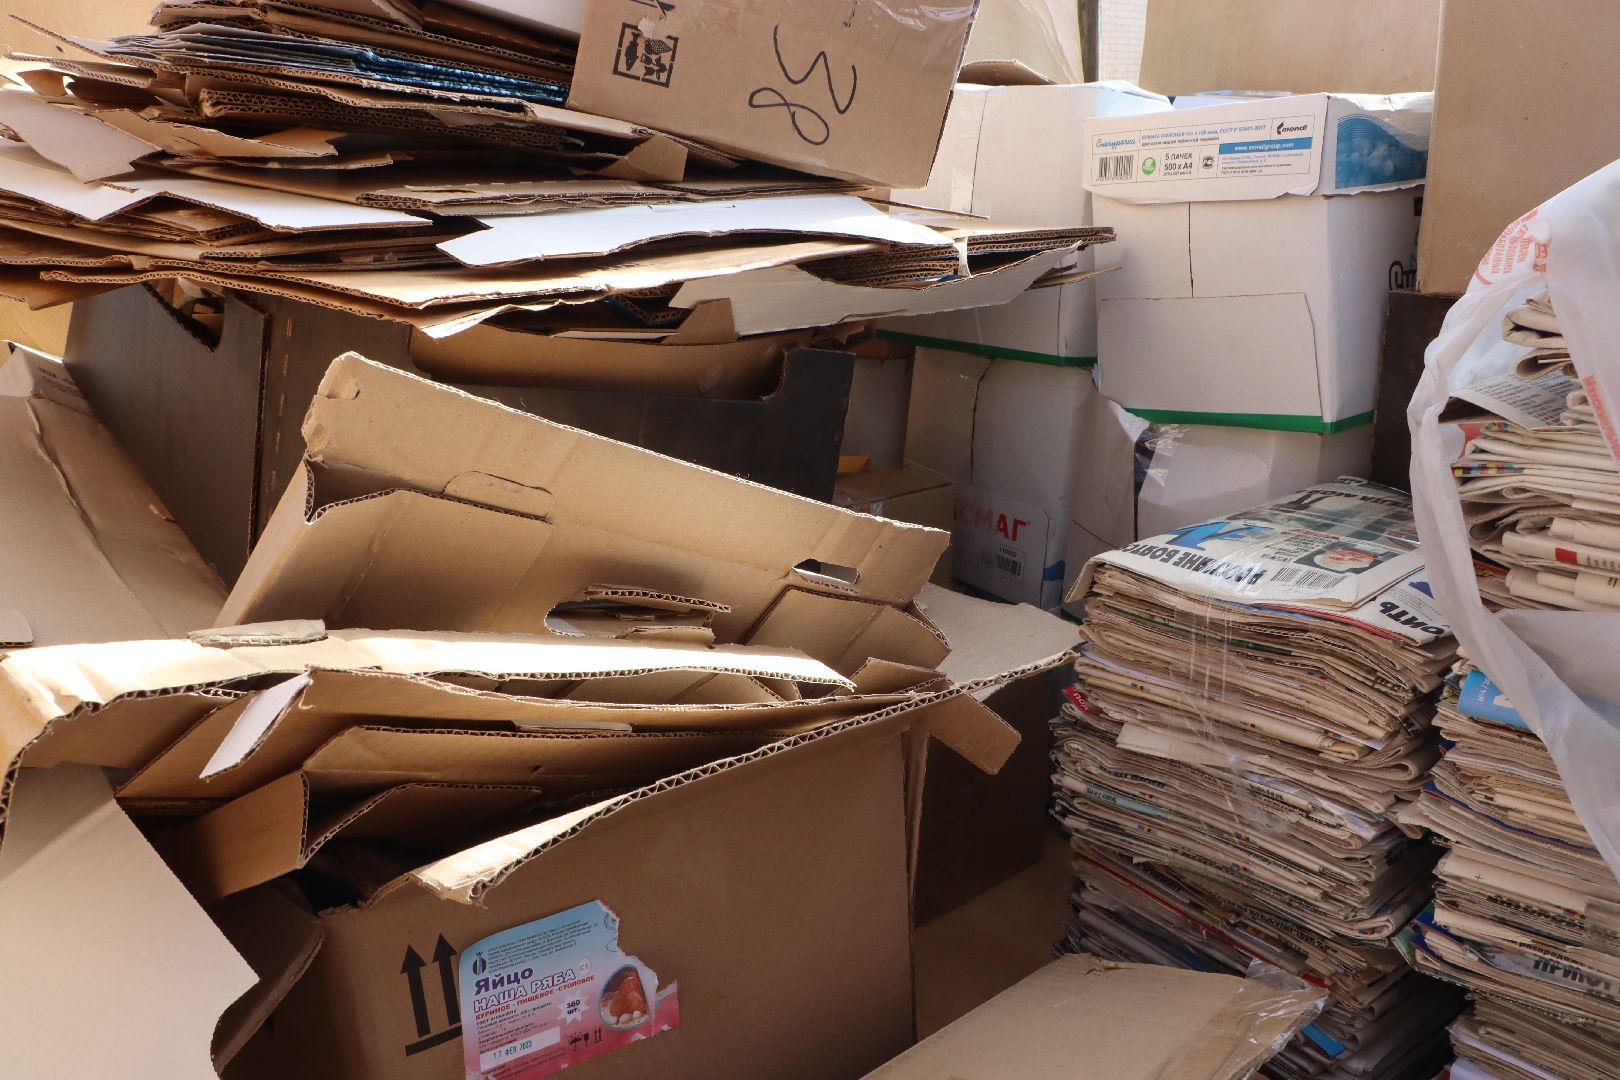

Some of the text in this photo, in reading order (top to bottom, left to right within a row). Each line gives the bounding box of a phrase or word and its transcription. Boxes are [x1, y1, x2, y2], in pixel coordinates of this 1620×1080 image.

[1281, 124, 1308, 133] mondi
[1095, 138, 1136, 150] Снегурочка
[1234, 142, 1294, 151] www.mondigroup.com
[1171, 152, 1193, 160] ПАЧЕК
[1164, 163, 1177, 171] 500
[474, 967, 534, 996] Яйцо
[473, 968, 577, 1013] НАША РЯБА
[475, 975, 596, 1021] КУРИНОЕ ПИЩЕВОЕ СТОЛОВОЕ
[566, 999, 581, 1009] 360
[566, 1008, 580, 1016] шт.
[504, 1046, 517, 1056] ФЕВ
